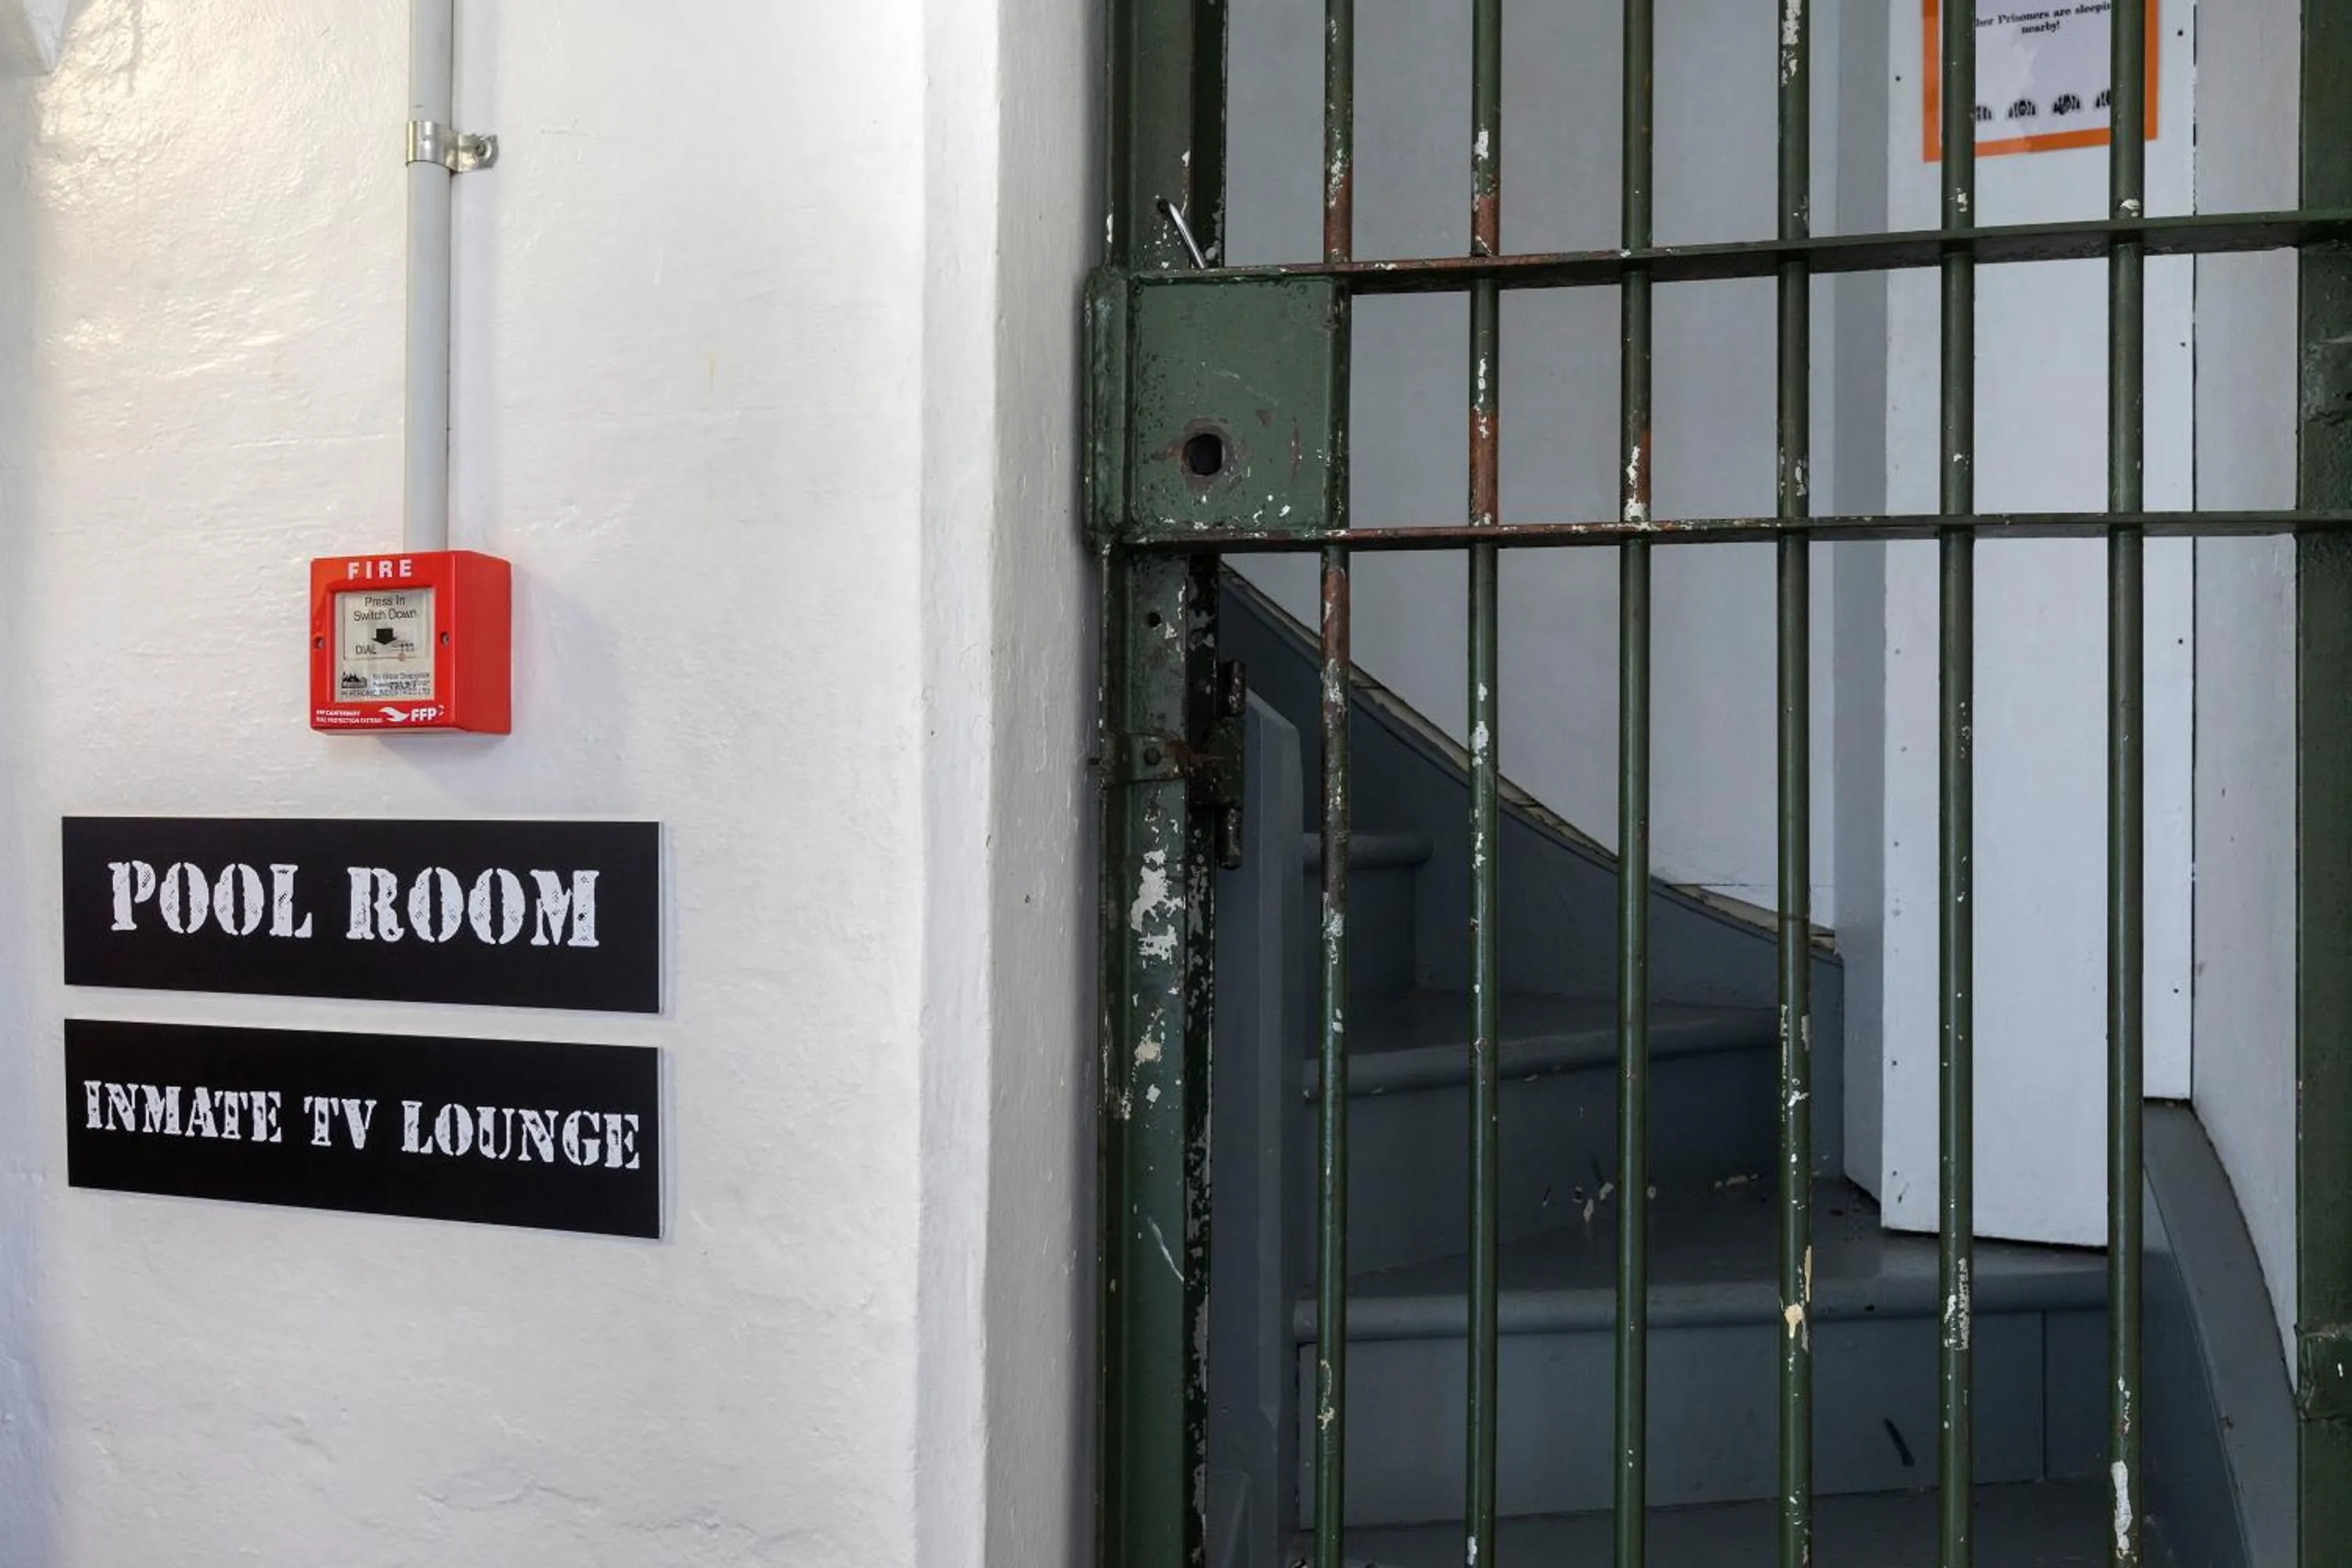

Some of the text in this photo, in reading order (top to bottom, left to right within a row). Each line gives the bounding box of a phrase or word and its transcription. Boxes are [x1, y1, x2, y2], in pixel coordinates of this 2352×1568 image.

[1975, 17, 1994, 27] her
[1998, 10, 2049, 24] Prisoners
[2053, 9, 2071, 17] are
[2022, 20, 2060, 34] nearby!
[347, 559, 412, 580] FIRE
[365, 595, 405, 606] Press In
[354, 608, 416, 621] Switch Down
[411, 708, 437, 721] FFP
[108, 861, 599, 947] POOL ROOM
[84, 1081, 639, 1168] INMATE TV LOUNGE
